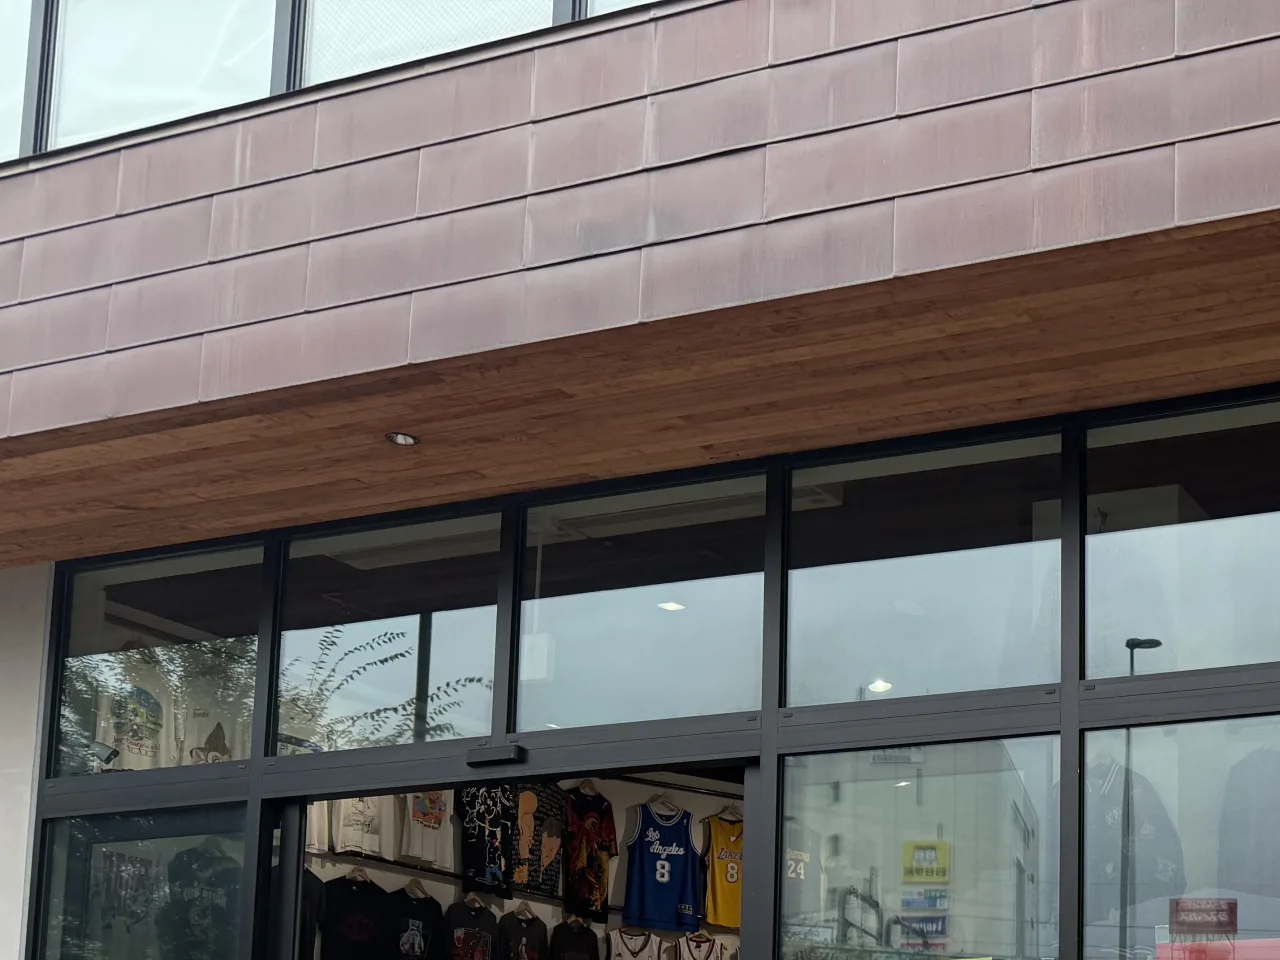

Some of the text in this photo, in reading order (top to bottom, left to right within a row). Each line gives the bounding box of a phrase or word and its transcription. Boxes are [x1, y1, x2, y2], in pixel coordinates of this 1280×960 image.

[645, 827, 660, 841] Los
[650, 841, 685, 859] Angeles
[655, 860, 671, 883] 8
[726, 862, 738, 883] 8
[787, 860, 805, 879] 24
